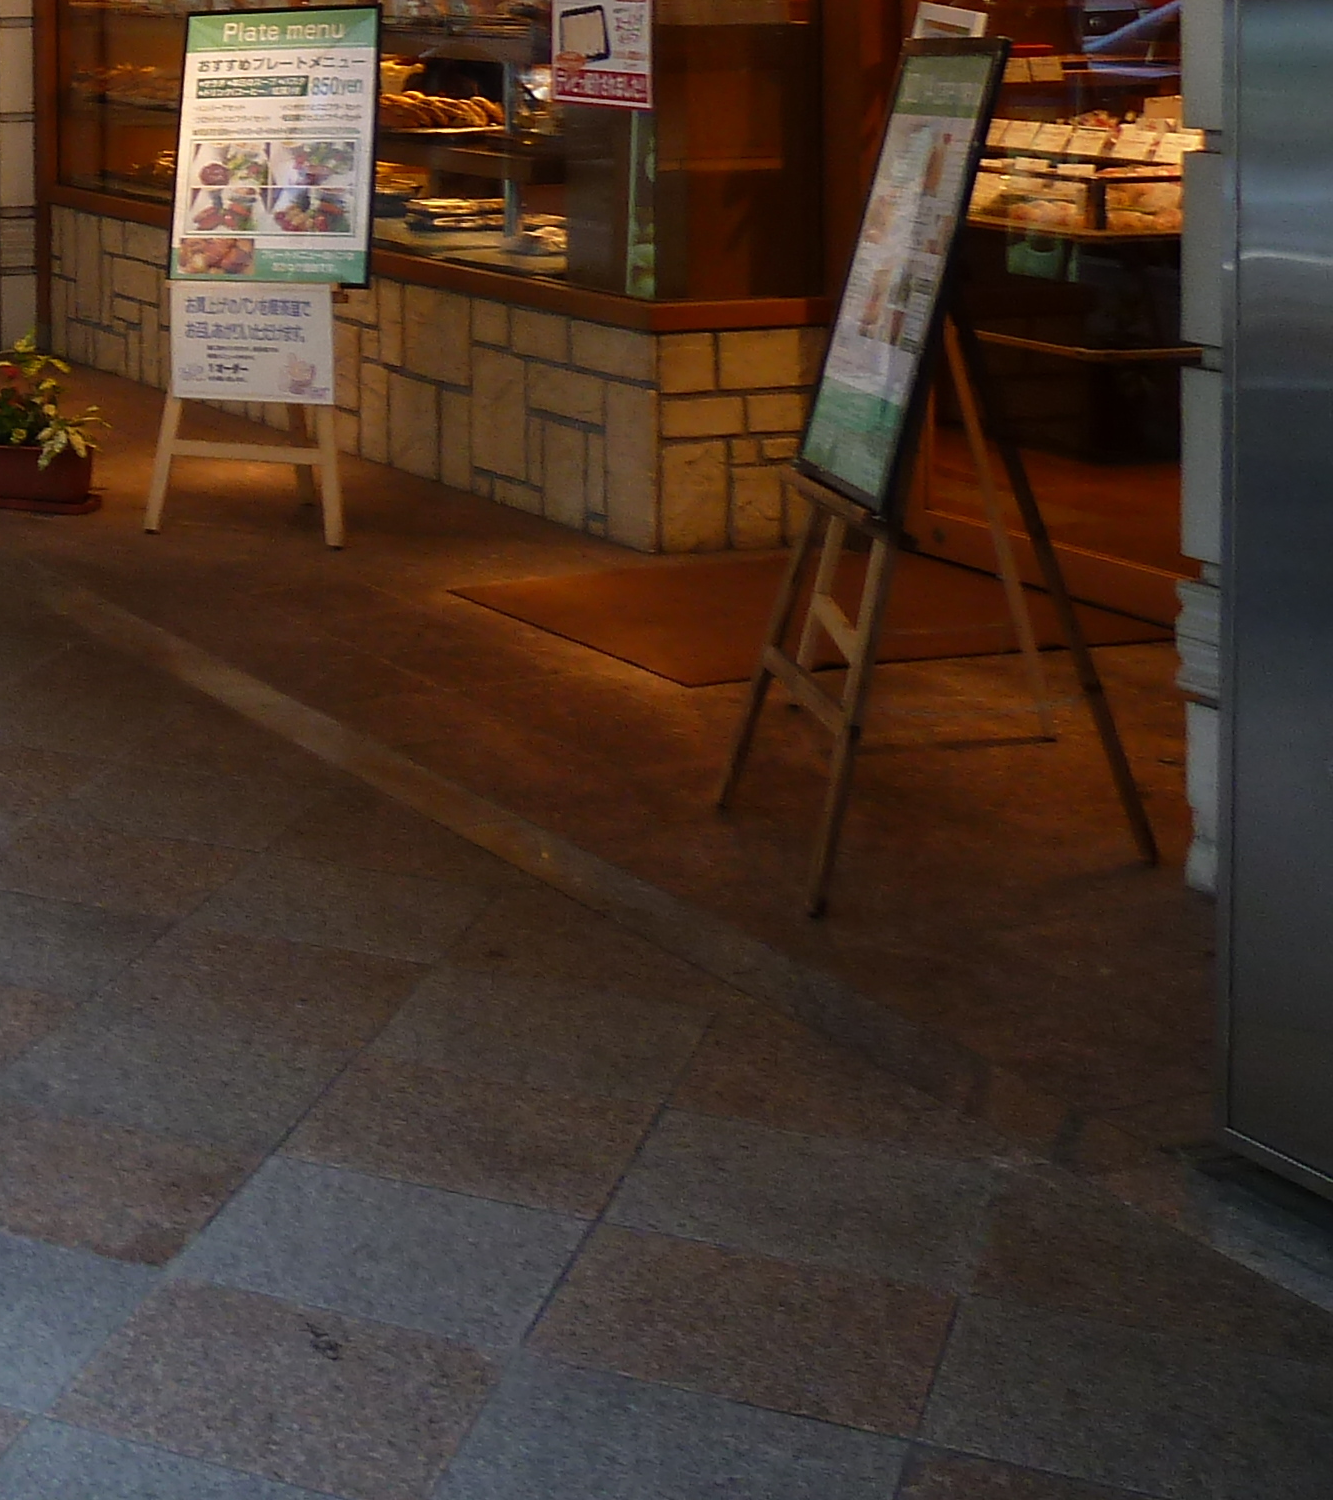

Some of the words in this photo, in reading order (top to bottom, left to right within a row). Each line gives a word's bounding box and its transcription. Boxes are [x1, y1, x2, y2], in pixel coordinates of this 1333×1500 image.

[221, 21, 280, 43] Plate
[286, 21, 346, 40] menu
[197, 56, 367, 73] おすすめプレートメニュー
